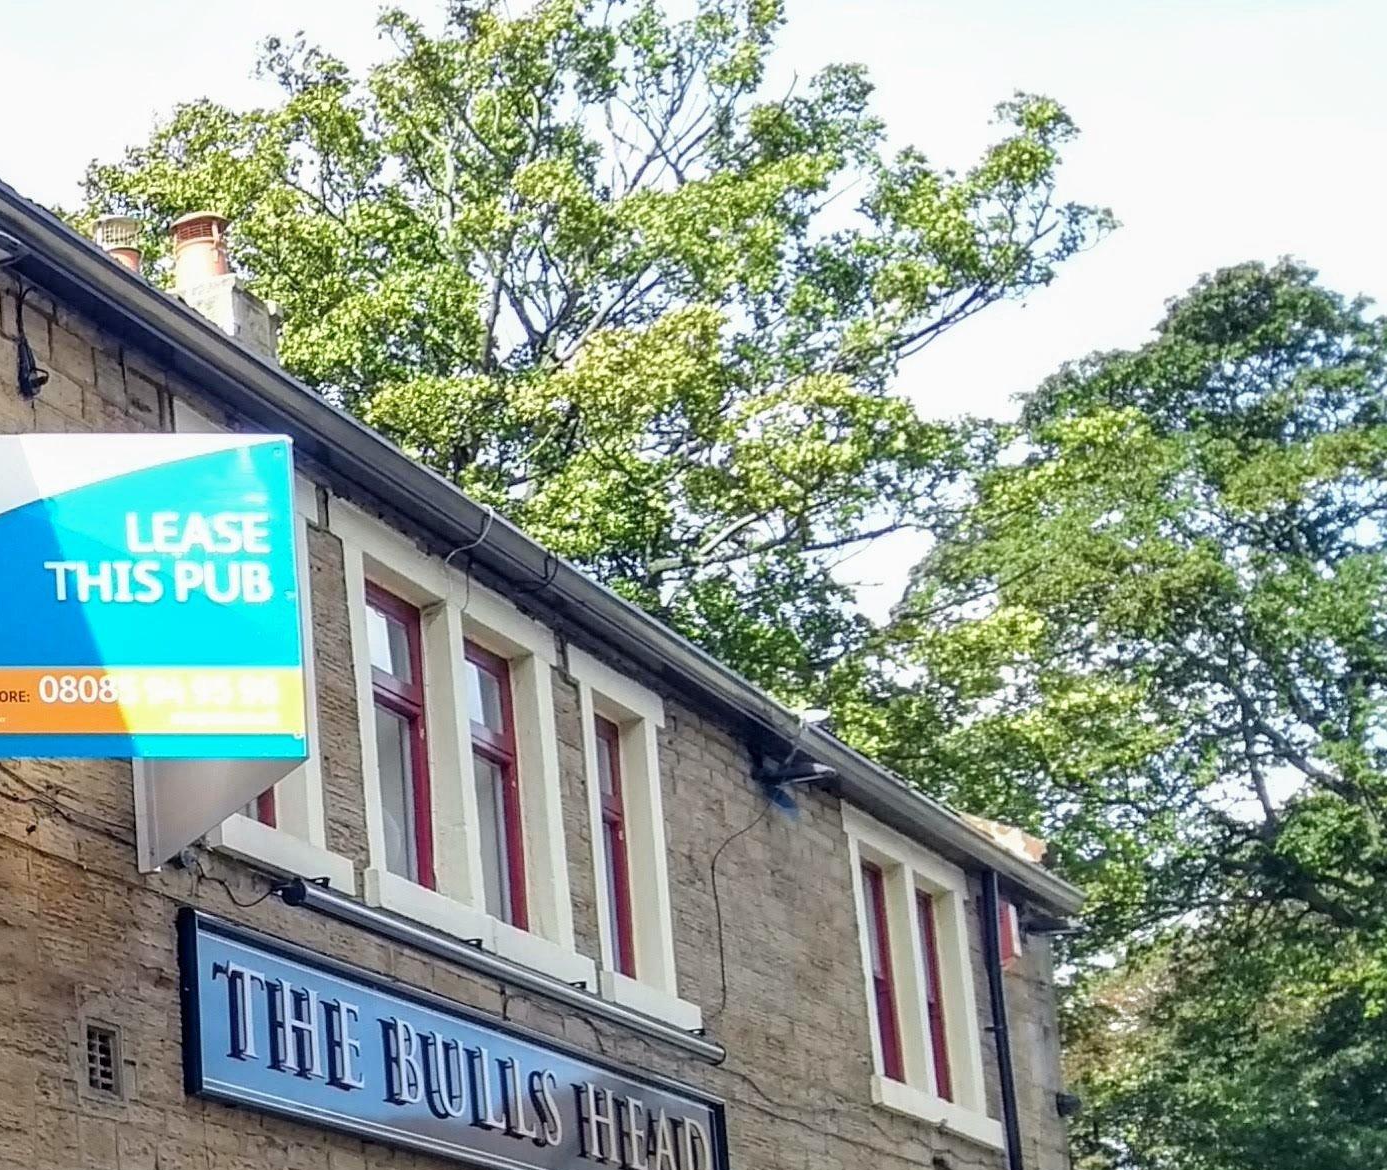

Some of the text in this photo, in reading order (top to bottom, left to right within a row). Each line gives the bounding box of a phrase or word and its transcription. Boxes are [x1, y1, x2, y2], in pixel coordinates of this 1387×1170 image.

[125, 511, 272, 554] LEASE
[43, 559, 274, 604] THIS PUB
[219, 959, 365, 1090] THE
[382, 1016, 564, 1147] BULLS
